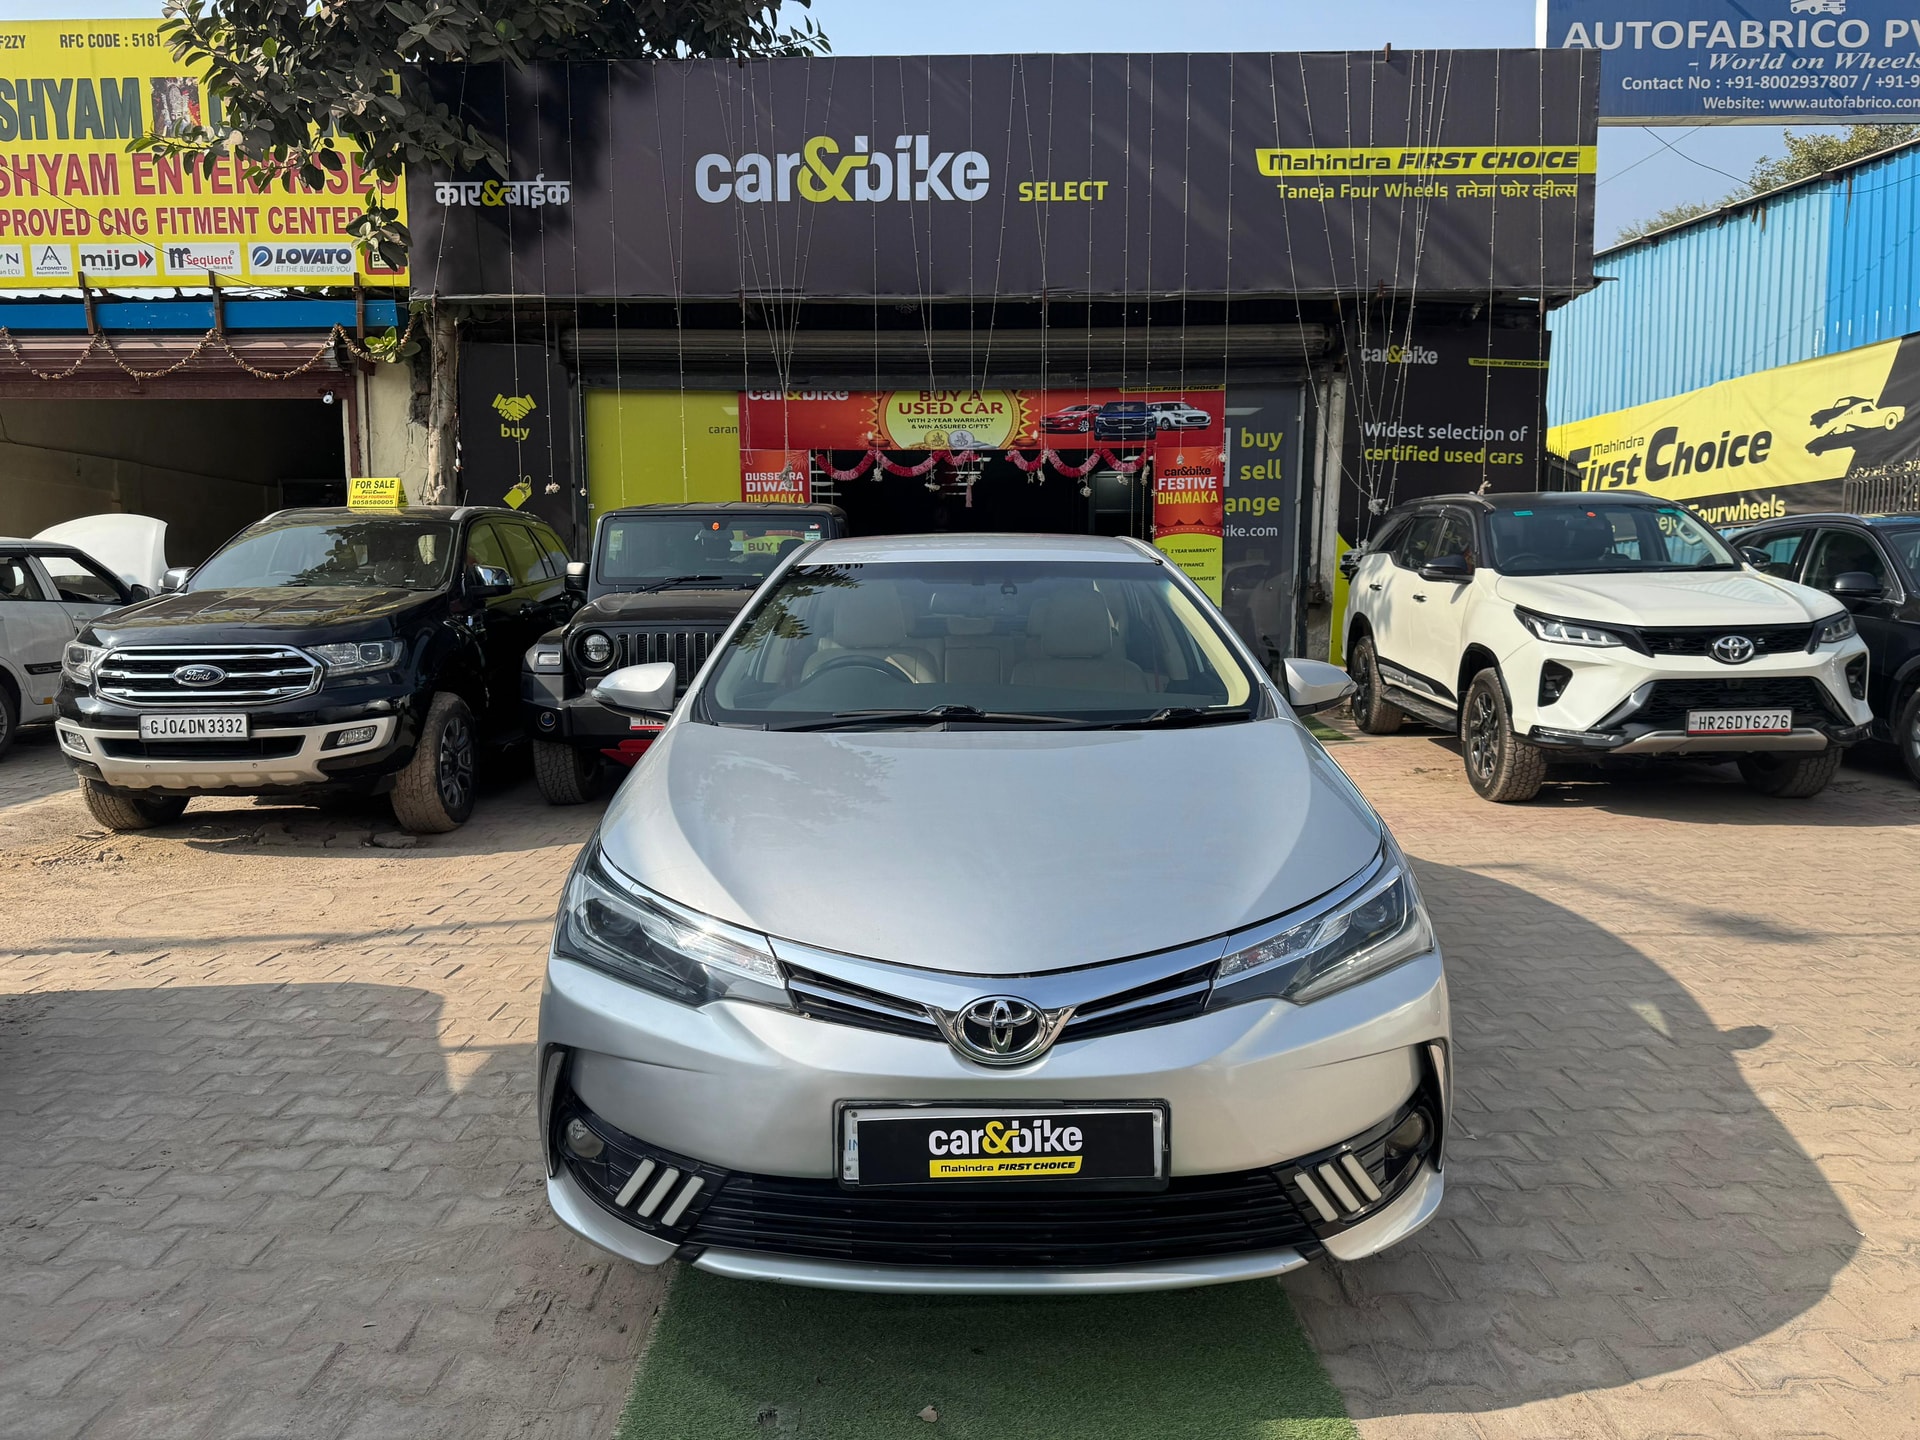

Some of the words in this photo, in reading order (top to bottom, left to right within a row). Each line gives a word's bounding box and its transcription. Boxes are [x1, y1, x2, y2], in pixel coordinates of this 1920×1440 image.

[60, 34, 84, 48] RFC
[88, 34, 120, 48] CODE
[132, 33, 161, 47] 5181
[1562, 19, 1870, 49] AUTOFABRICO
[1709, 53, 1785, 70] World
[1792, 57, 1824, 69] on
[1834, 52, 1920, 70] Wheels
[1622, 76, 1684, 90] Contact
[1688, 77, 1711, 89] No
[1724, 75, 1858, 90] +91-8002937807
[0, 77, 144, 142] SHYAM
[1703, 96, 1764, 109] Website:
[695, 135, 990, 203] car&bike
[1019, 181, 1108, 202] SELECT
[1269, 154, 1391, 171] Mahindra
[1397, 152, 1477, 169] FIRST
[1482, 151, 1580, 168] CHOICE
[1277, 184, 1335, 201] Taneja
[1340, 184, 1379, 198] Four
[1384, 182, 1448, 198] Wheels
[1456, 180, 1498, 198] तनेजा
[1500, 180, 1530, 197] फोर
[0, 208, 91, 236] PROVED
[98, 207, 148, 236] CNG
[157, 207, 260, 236] FITMENT
[81, 250, 138, 270] mijo
[276, 248, 352, 264] LOVATO
[1361, 345, 1438, 365] car&bike
[919, 390, 961, 402] BUY
[968, 390, 983, 402] A
[899, 402, 953, 415] USED
[960, 402, 1004, 415] CAR
[501, 424, 530, 441] buy
[1241, 427, 1283, 451] buy
[1365, 422, 1424, 439] Widest
[1428, 423, 1504, 441] selection
[1509, 425, 1528, 442] of
[1593, 436, 1644, 456] Mahindra
[1645, 426, 1772, 482] Choice
[1364, 445, 1439, 463] certified
[1444, 448, 1486, 464] used
[1489, 451, 1523, 465] cars
[745, 472, 804, 480] DUSSERA
[1164, 466, 1211, 476] car&bike
[1240, 459, 1282, 480] sell
[374, 480, 395, 488] SALE
[746, 481, 803, 492] DIWALI
[1158, 477, 1217, 490] FESTIVE
[1158, 491, 1219, 504] DHAMAKA
[1224, 497, 1281, 516] ange
[748, 542, 773, 552] BUY
[184, 669, 212, 681] Ford
[151, 718, 243, 735] GJ04DN3332
[1699, 714, 1789, 730] HR26DY6276
[929, 1120, 1082, 1156] car&bike
[940, 1165, 994, 1173] Mahindra
[998, 1162, 1032, 1171] FIRST
[1033, 1161, 1076, 1171] CHOICE
